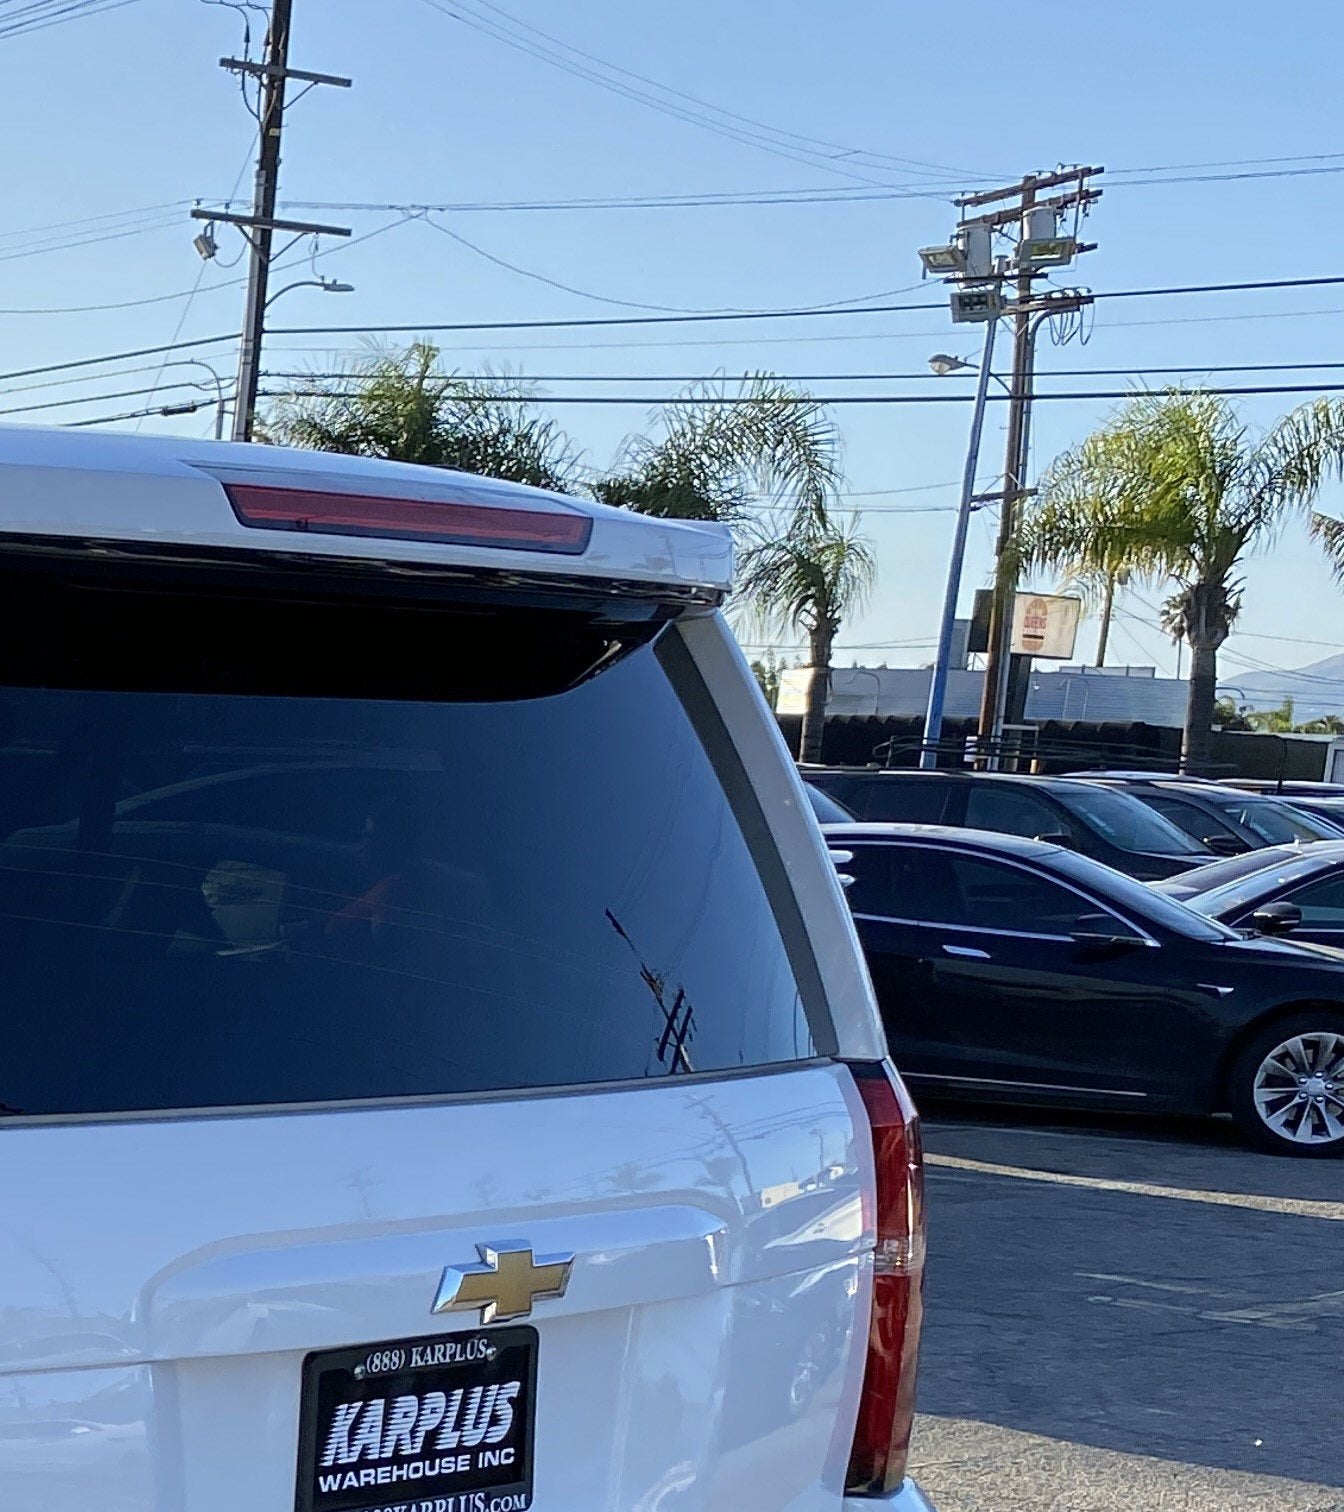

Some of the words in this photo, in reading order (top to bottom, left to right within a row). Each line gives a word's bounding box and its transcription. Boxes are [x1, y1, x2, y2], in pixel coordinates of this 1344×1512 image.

[366, 1349, 405, 1374] (888)
[411, 1338, 488, 1368] KARPLUS
[318, 1381, 520, 1467] KARPLUS
[318, 1454, 471, 1493] WAREHOUSE
[478, 1447, 516, 1470] INC
